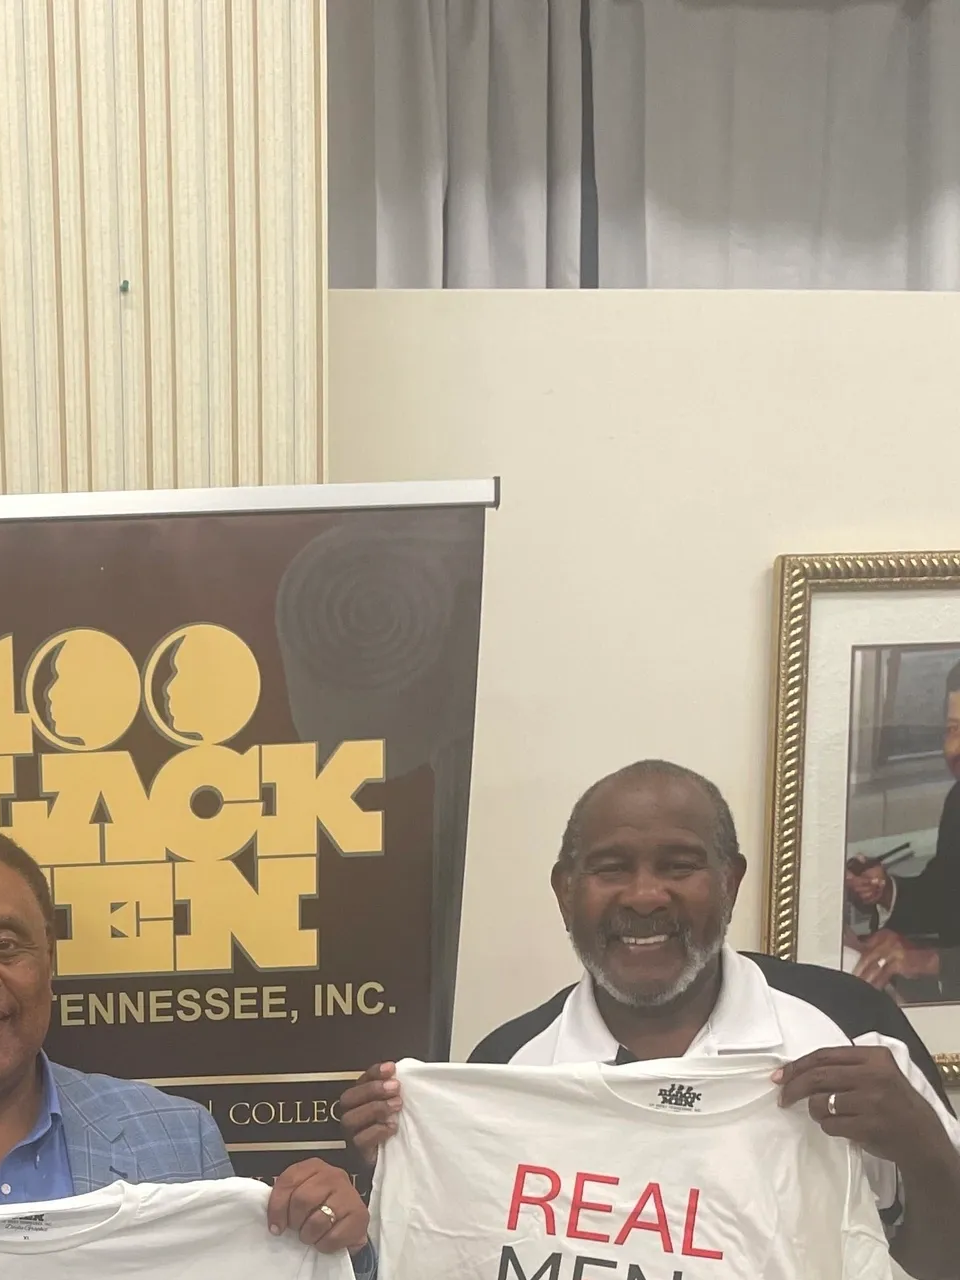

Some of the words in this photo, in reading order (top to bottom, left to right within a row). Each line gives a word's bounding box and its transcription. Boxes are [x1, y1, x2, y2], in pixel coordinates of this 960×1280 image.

[43, 854, 320, 978] EN
[52, 983, 299, 1027] ENNESSEE,
[313, 980, 397, 1018] INC.
[506, 1163, 724, 1260] REAL
